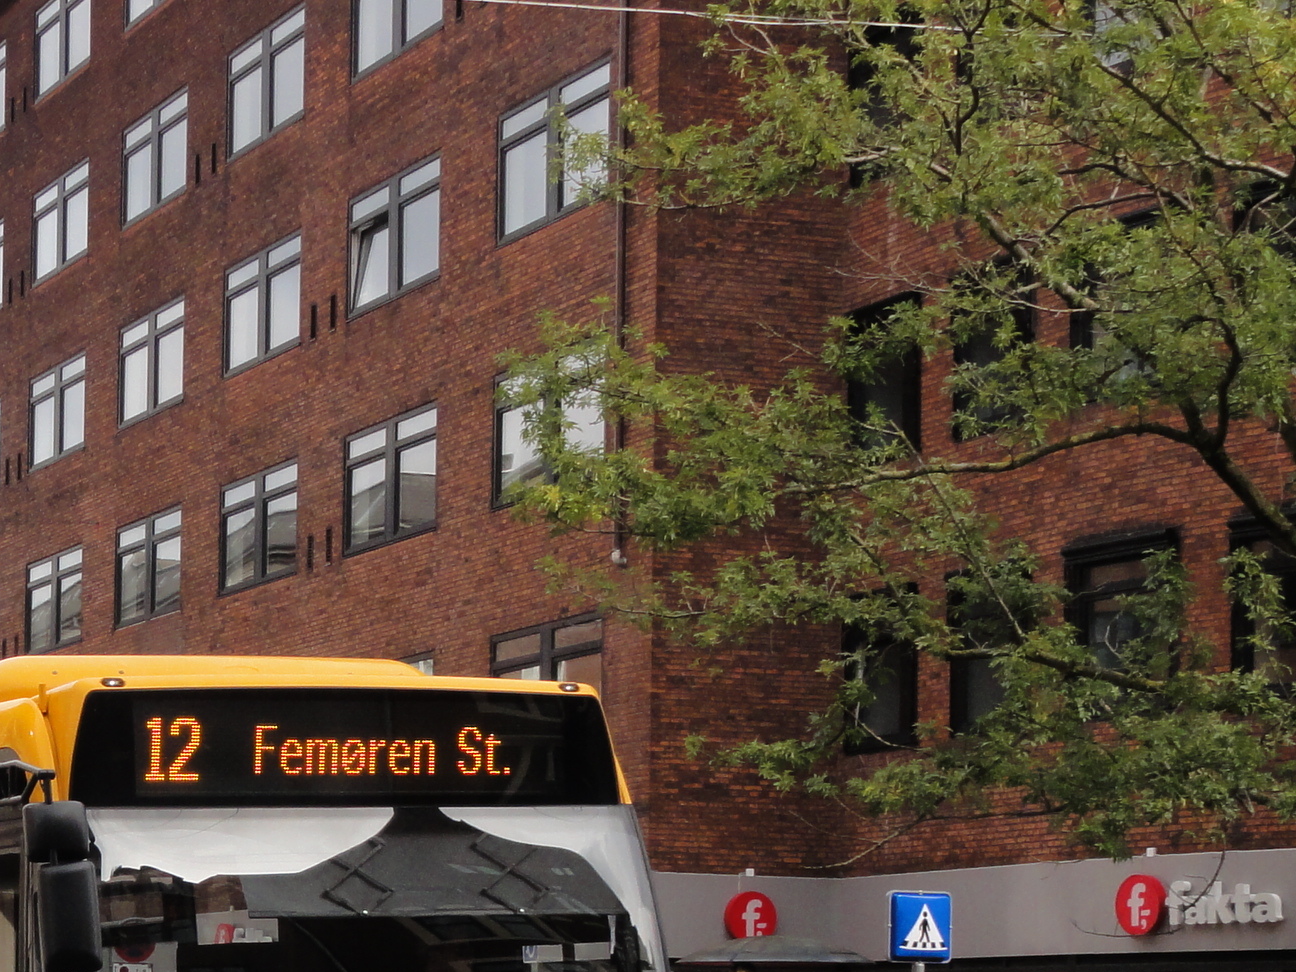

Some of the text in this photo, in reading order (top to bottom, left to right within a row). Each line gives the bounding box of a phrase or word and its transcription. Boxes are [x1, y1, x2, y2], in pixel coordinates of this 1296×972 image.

[144, 716, 512, 782] 12 Femøren St.
[1165, 880, 1284, 926] fakta
